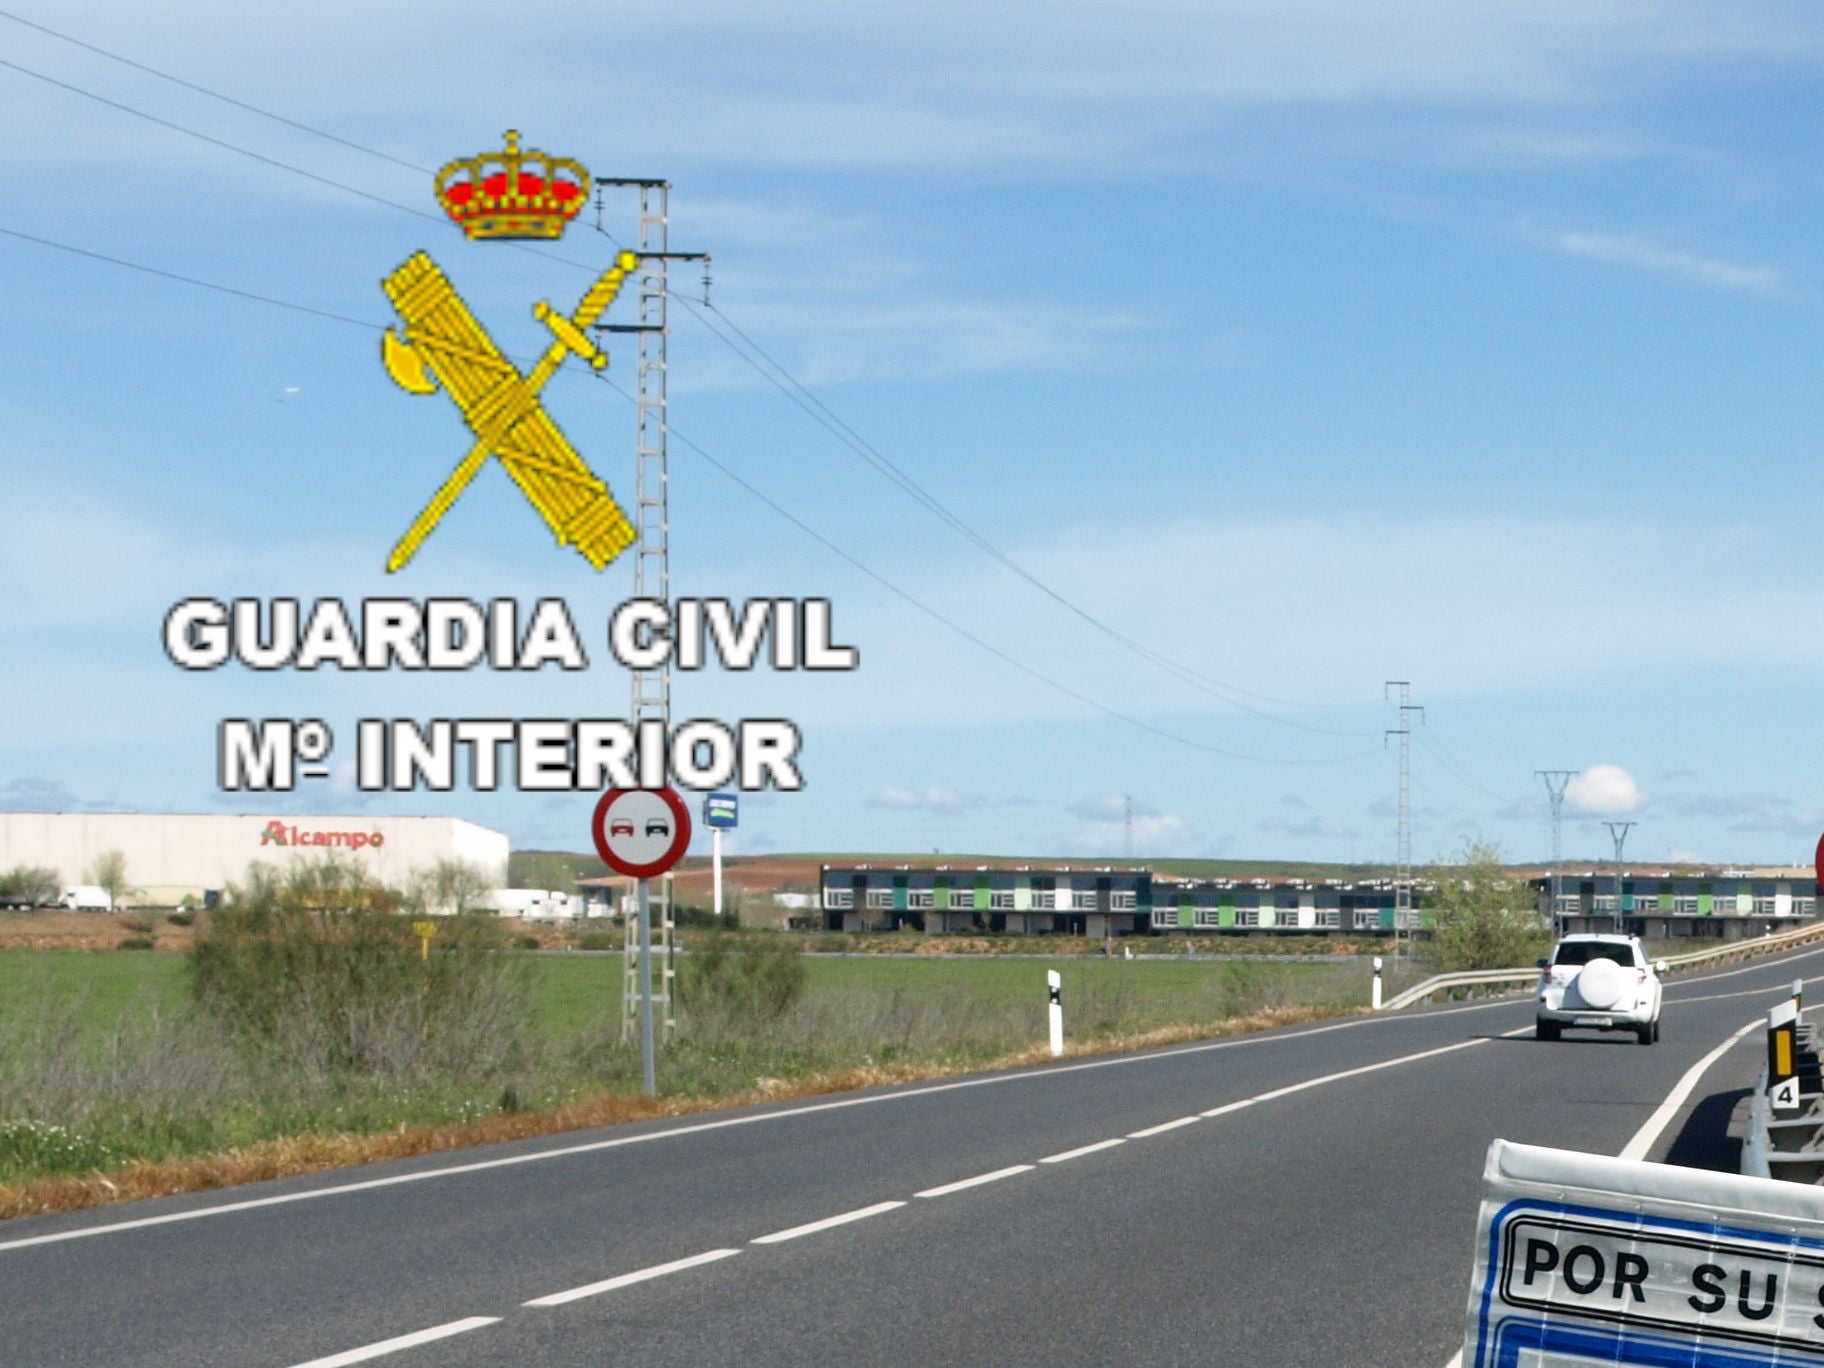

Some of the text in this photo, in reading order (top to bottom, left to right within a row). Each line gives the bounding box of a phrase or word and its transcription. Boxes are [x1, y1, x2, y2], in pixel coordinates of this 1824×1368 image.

[261, 820, 385, 850] Alcampo
[1778, 1086, 1793, 1103] 4
[1523, 1238, 1649, 1304] POR
[1688, 1263, 1778, 1320] SU
